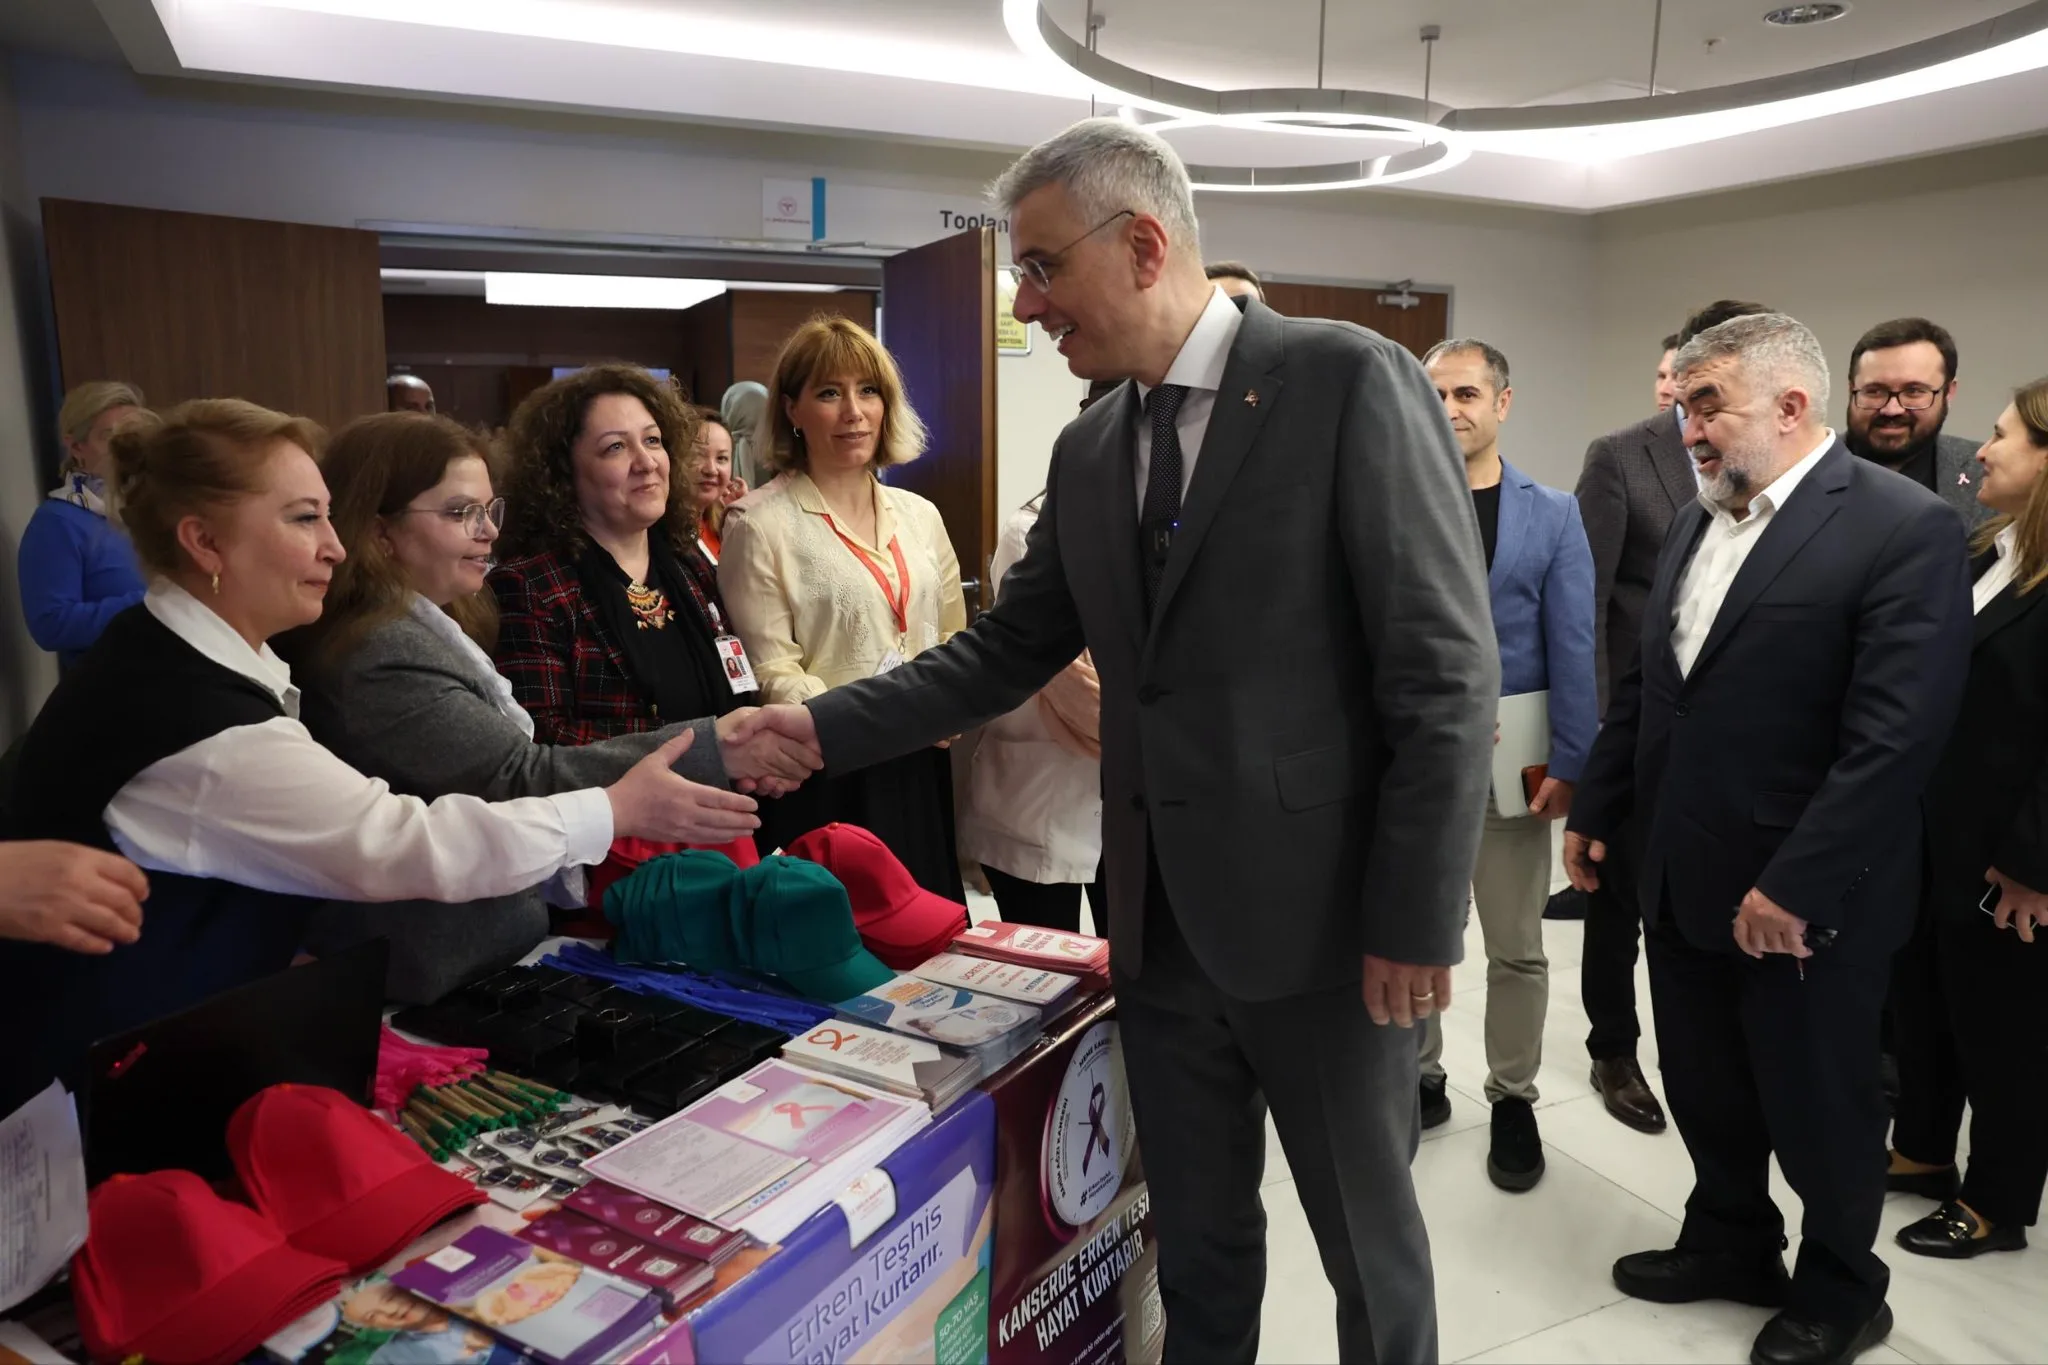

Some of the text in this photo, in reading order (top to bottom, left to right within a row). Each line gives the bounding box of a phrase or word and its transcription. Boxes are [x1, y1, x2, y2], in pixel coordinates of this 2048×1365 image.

[787, 1275, 863, 1360] Erken
[869, 1204, 943, 1281] Teşhis
[804, 1315, 860, 1365] ayat
[864, 1241, 944, 1328] Kurtarır.
[939, 1310, 963, 1342] 50-70
[999, 1254, 1076, 1348] KANSERDE
[1079, 1215, 1122, 1273] ERKEN
[1035, 1289, 1081, 1352] HAYAT
[1081, 1229, 1145, 1307] KURTARIR
